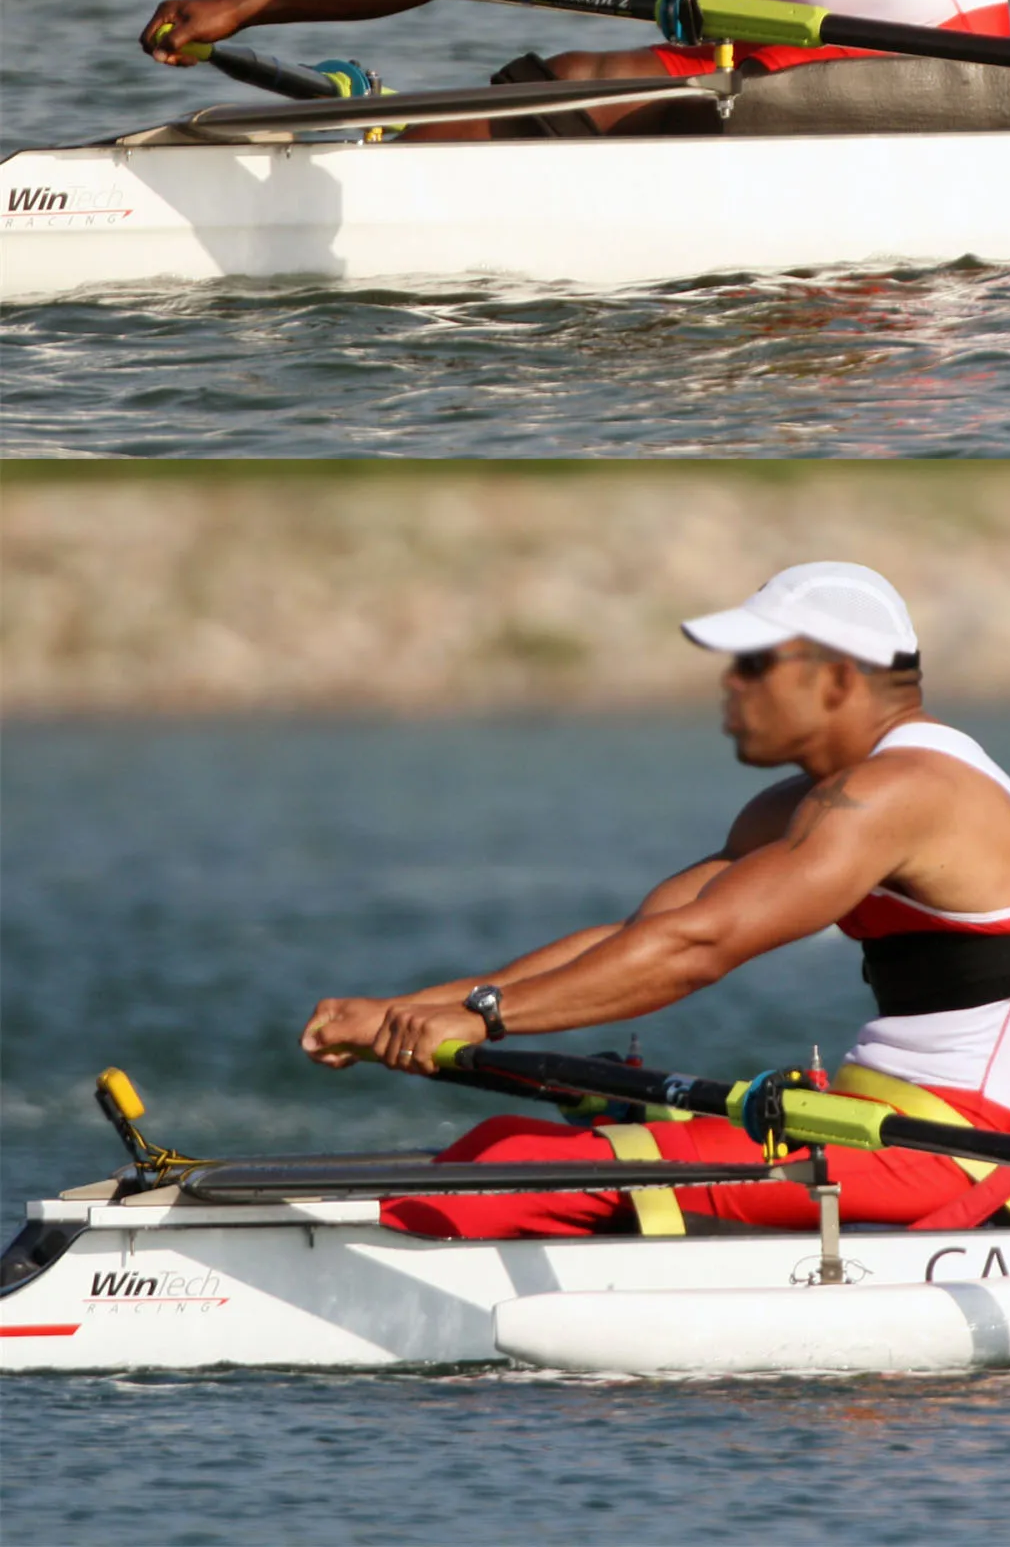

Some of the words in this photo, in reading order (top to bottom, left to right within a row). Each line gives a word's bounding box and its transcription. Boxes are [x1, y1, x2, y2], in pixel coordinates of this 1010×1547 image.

[7, 183, 124, 212] WinTech
[4, 214, 118, 228] RACING
[90, 1268, 221, 1297] WinTech
[86, 1302, 212, 1314] RACING
